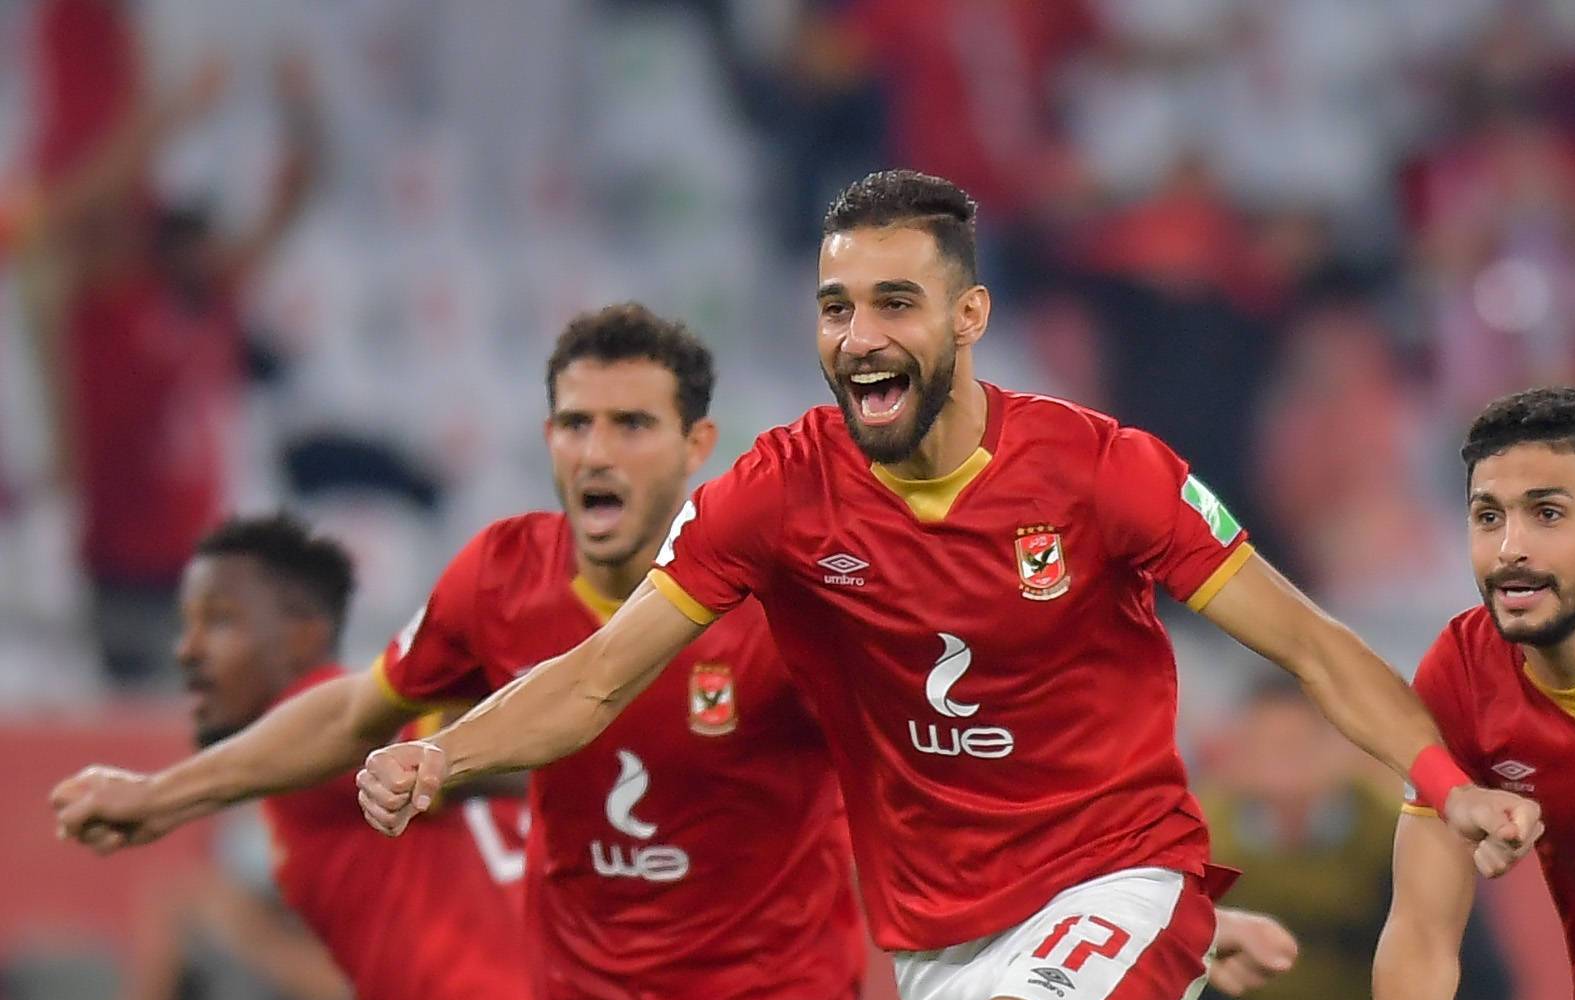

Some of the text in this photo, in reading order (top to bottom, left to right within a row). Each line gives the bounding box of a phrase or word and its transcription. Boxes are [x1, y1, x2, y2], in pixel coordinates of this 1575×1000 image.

[823, 574, 865, 586] umbro
[908, 719, 1014, 758] we
[590, 839, 690, 881] we
[1031, 914, 1132, 973] 17
